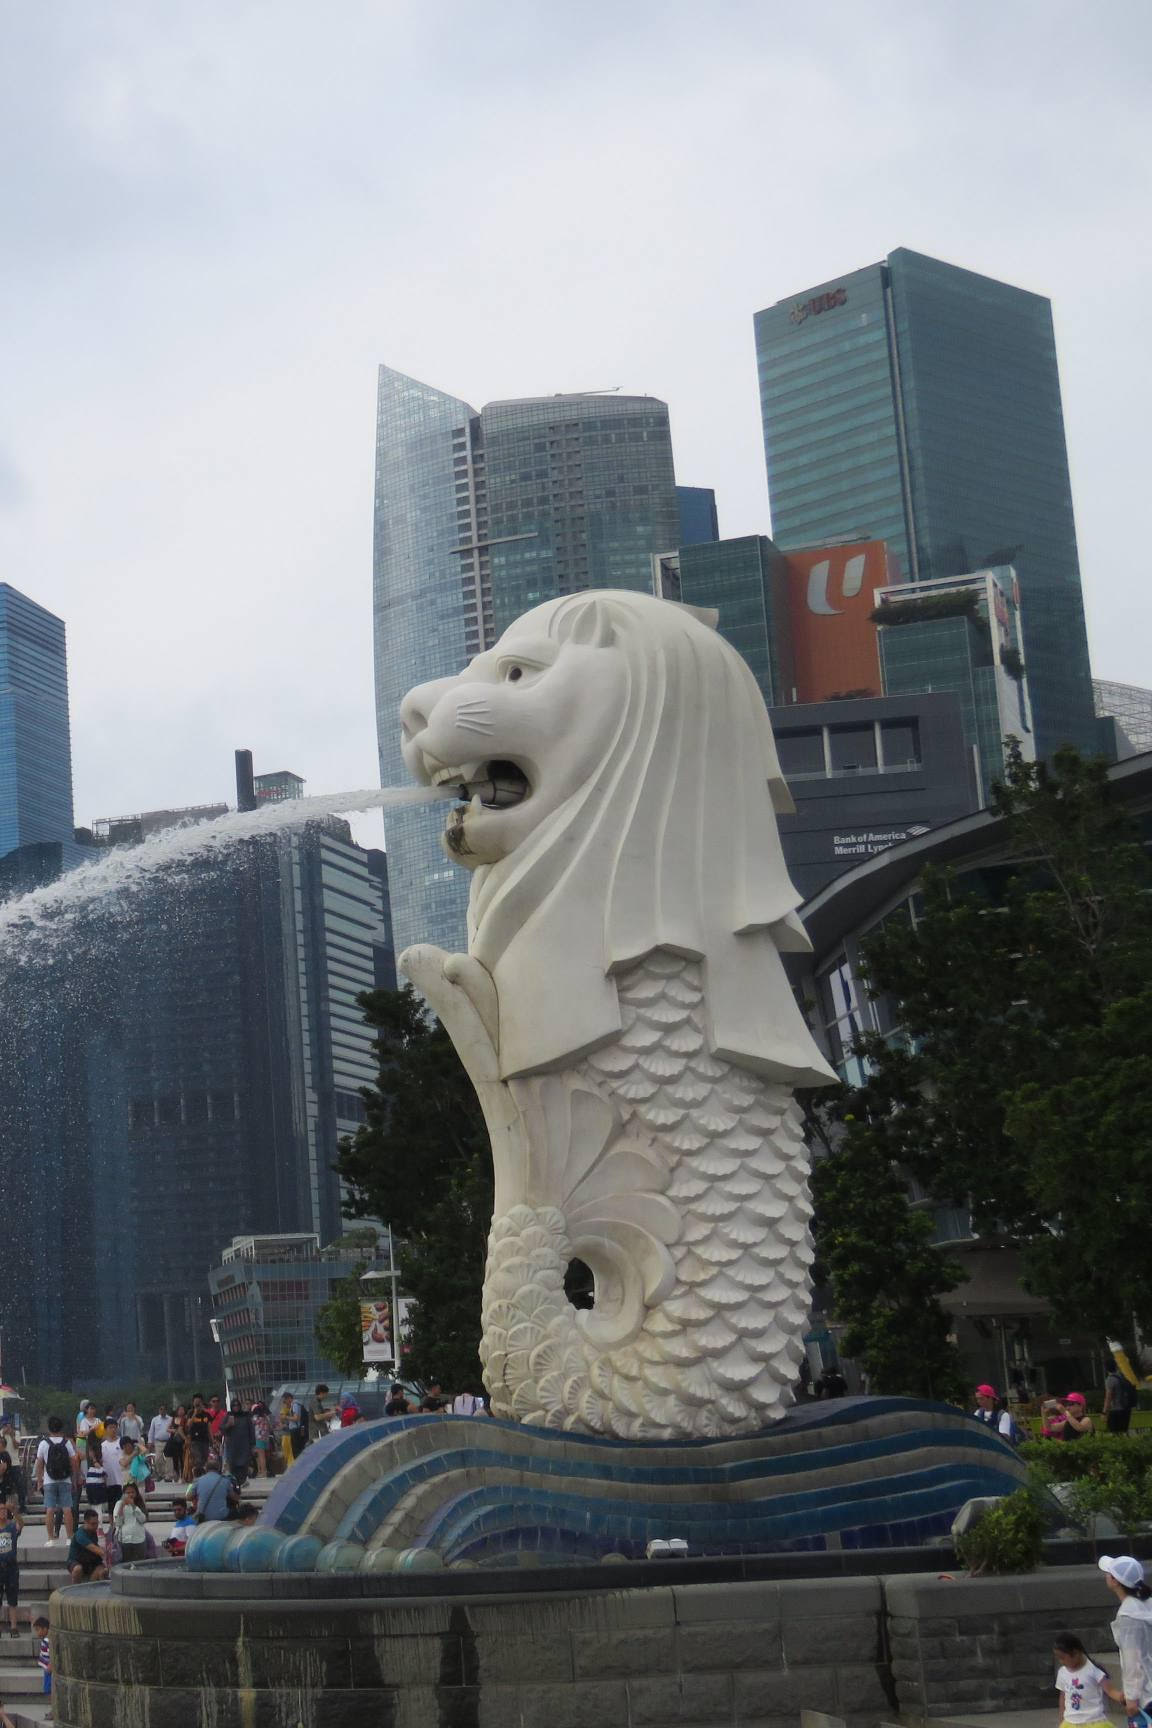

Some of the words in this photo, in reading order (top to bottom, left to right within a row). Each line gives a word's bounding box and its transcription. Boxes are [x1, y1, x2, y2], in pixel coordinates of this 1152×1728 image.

[833, 834, 857, 845] Bank
[857, 833, 867, 843] of
[868, 831, 906, 842] America
[834, 844, 866, 855] Merrill
